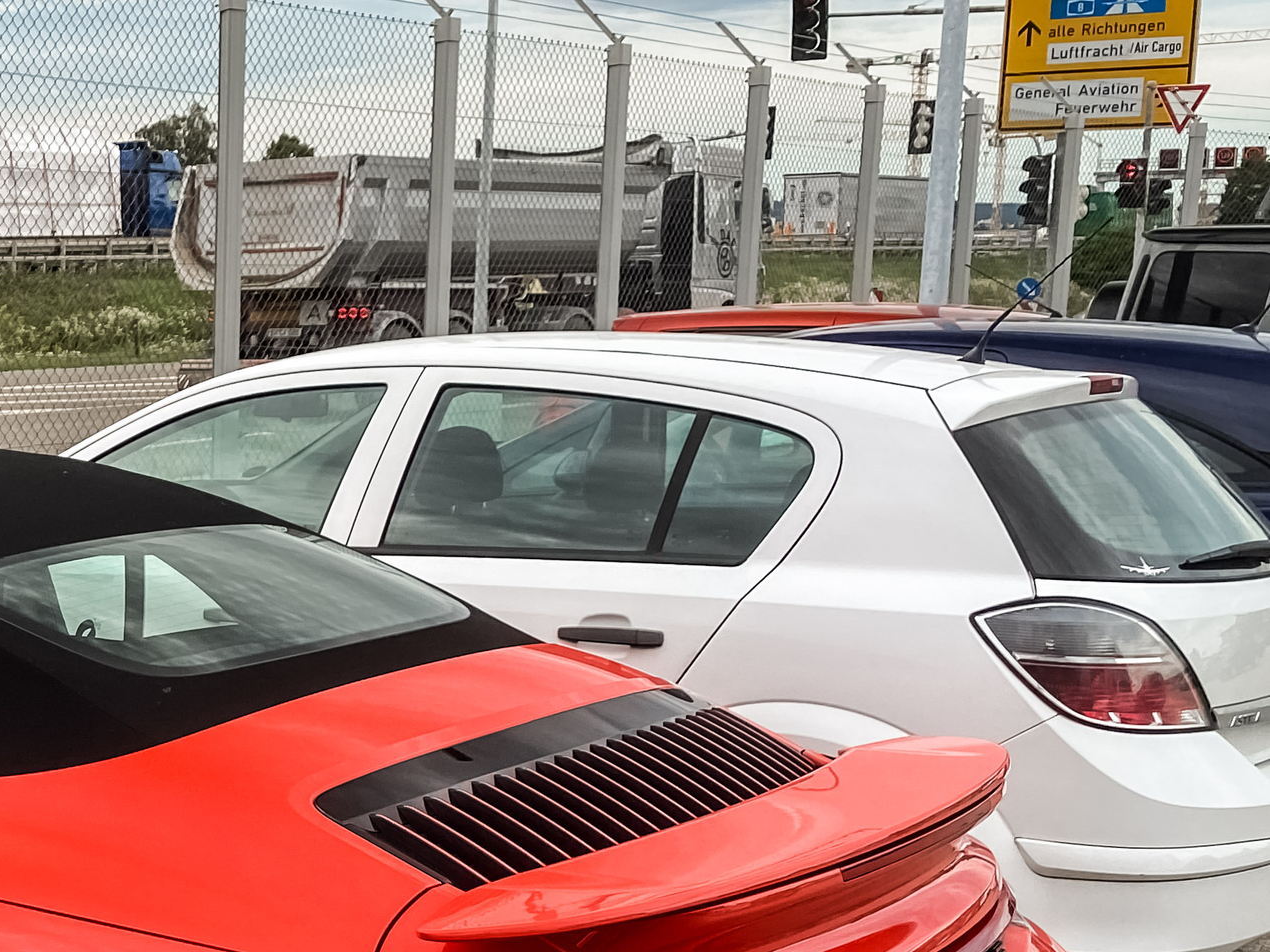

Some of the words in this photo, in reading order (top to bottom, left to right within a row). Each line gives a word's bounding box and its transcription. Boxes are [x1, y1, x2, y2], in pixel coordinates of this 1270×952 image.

[1048, 25, 1075, 38] alle
[1082, 22, 1166, 37] Richtungen
[1051, 44, 1124, 60] Luftfracht
[1152, 40, 1182, 55] Cargo
[1078, 83, 1139, 97] Aviation
